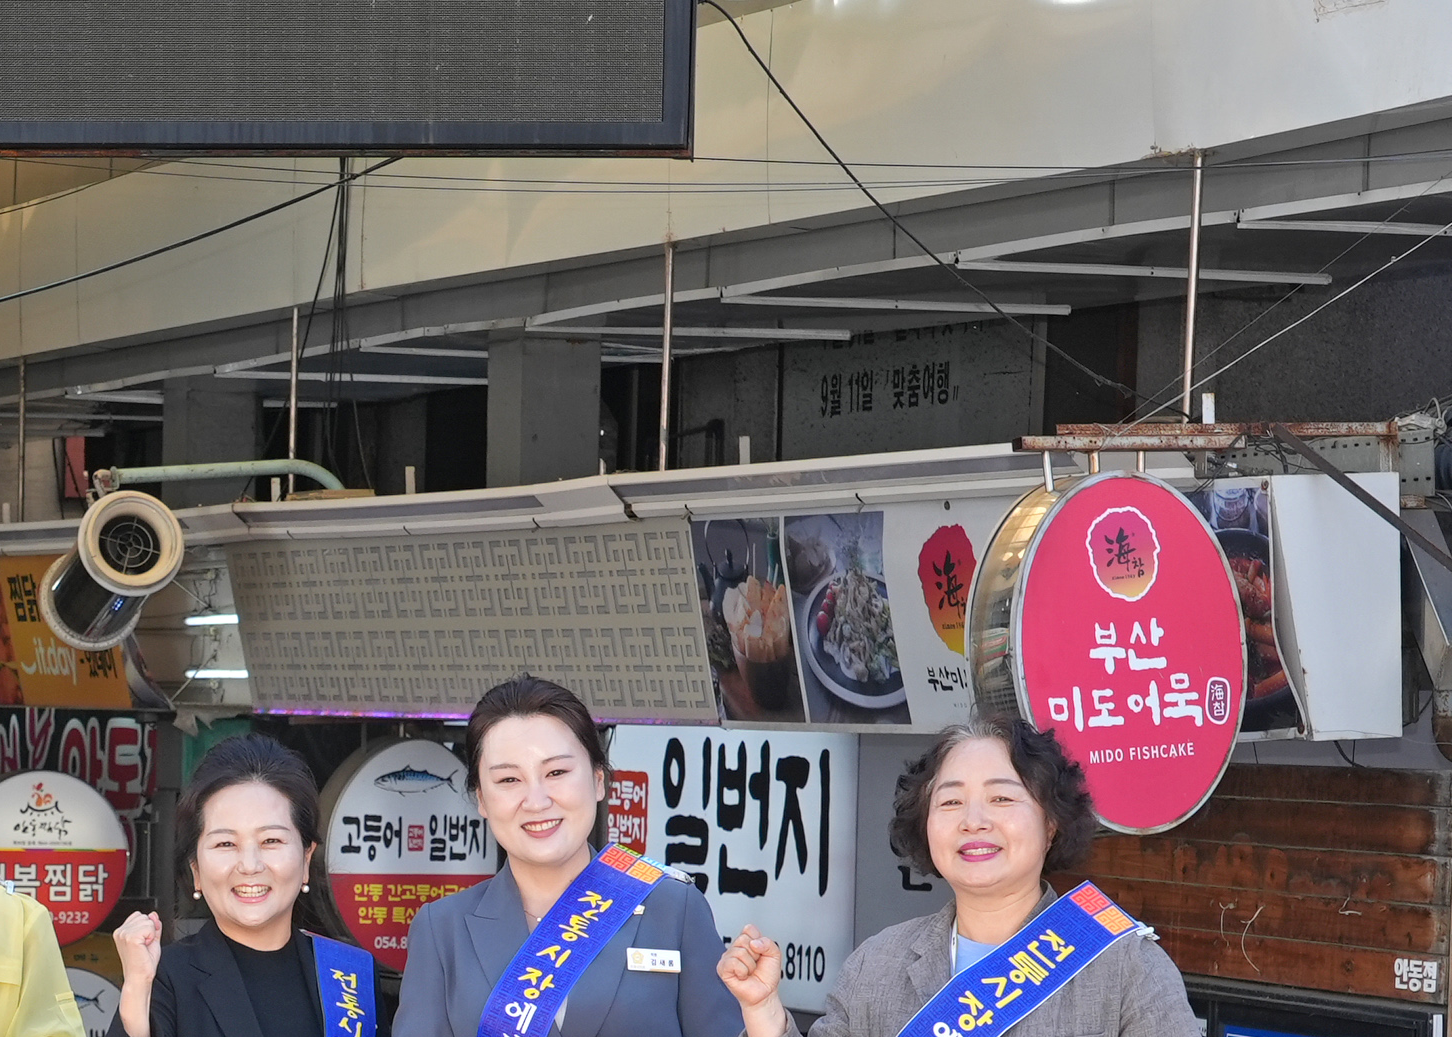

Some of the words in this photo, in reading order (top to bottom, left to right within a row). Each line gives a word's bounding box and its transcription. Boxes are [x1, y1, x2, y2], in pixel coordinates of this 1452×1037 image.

[1089, 617, 1167, 674] 부산
[927, 666, 968, 692] 부산미
[1048, 673, 1204, 732] 미도어묵
[1089, 748, 1124, 764] MIDO
[1129, 742, 1196, 761] FISHCAKE
[608, 780, 646, 810] 고등어
[608, 813, 646, 845] 일번지
[663, 737, 831, 898] 일번지
[341, 814, 403, 862] 고등어
[429, 814, 487, 862] 일번지
[354, 884, 384, 902] 안동
[358, 907, 388, 925] 안동
[1394, 957, 1438, 994] 안동점
